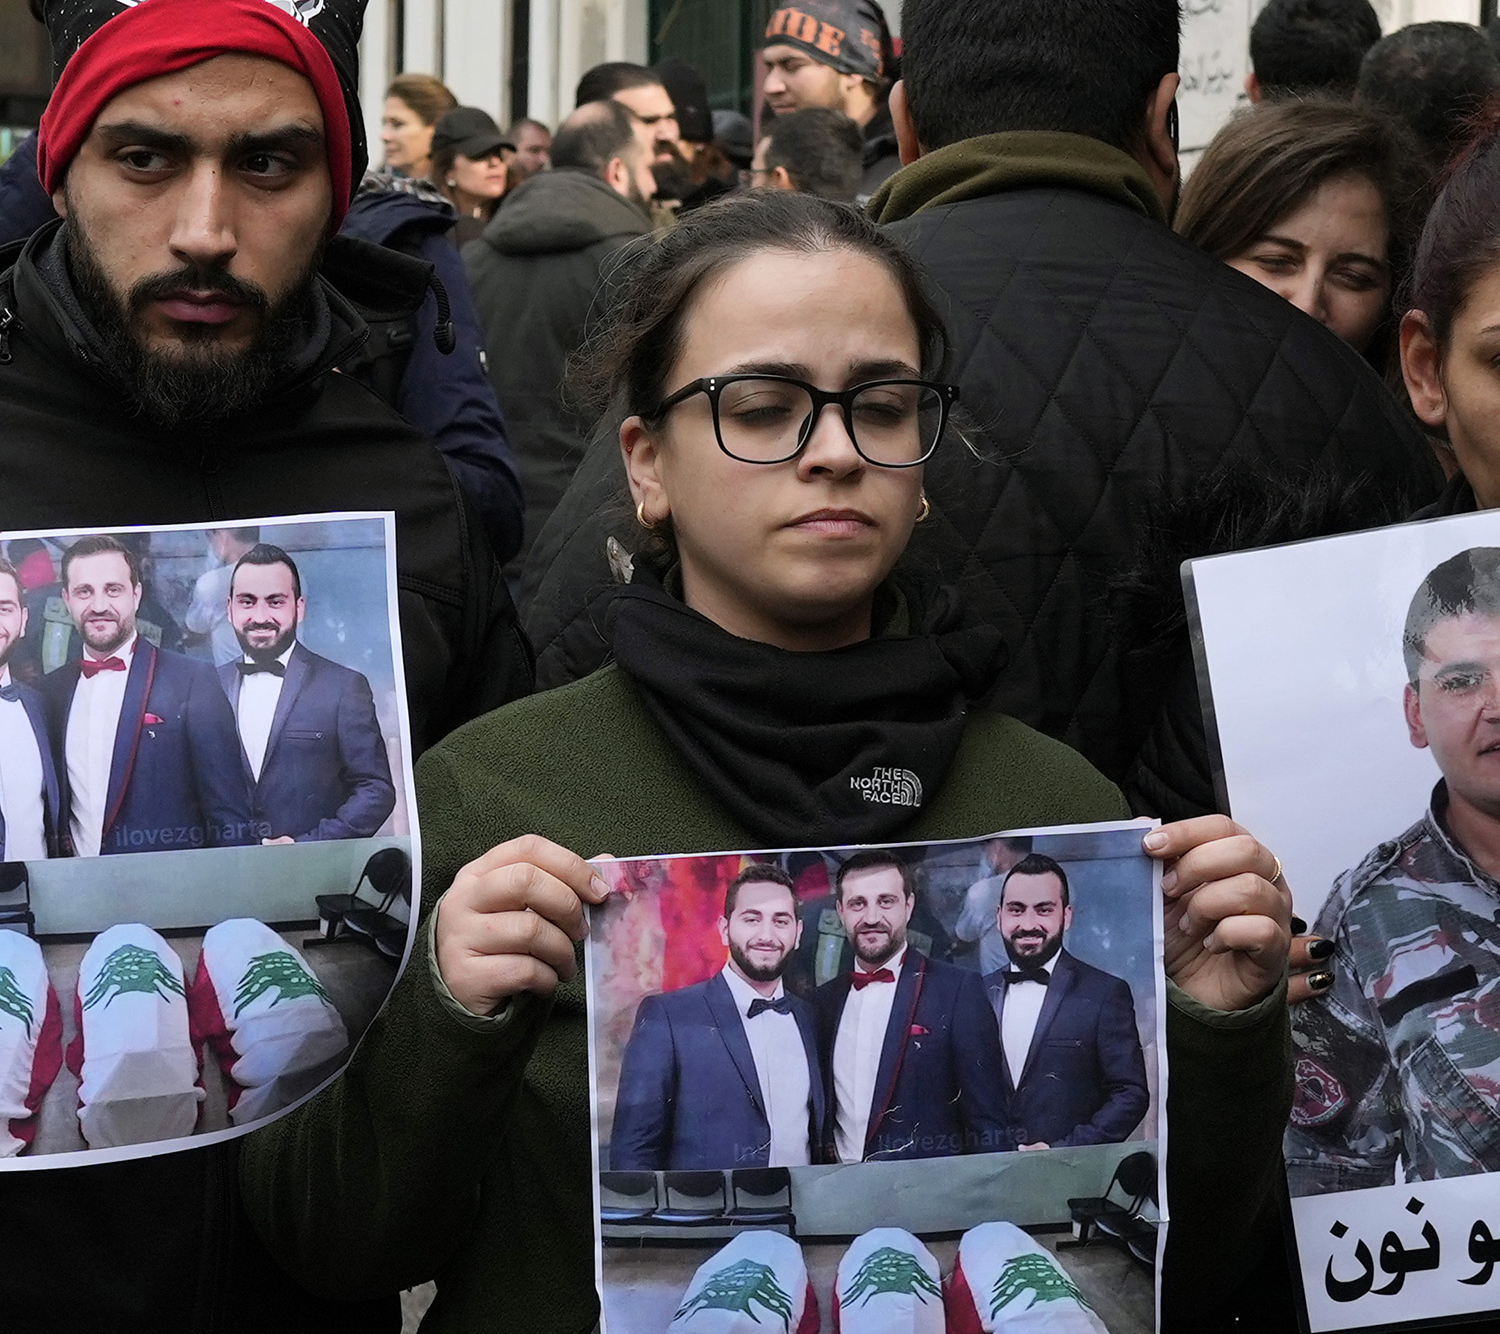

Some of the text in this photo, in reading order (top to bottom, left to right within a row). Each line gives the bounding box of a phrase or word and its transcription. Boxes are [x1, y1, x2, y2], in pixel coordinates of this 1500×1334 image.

[873, 767, 902, 780] THE
[850, 777, 901, 793] NORTH
[862, 790, 901, 804] FACE
[1324, 1196, 1441, 1302] نون
